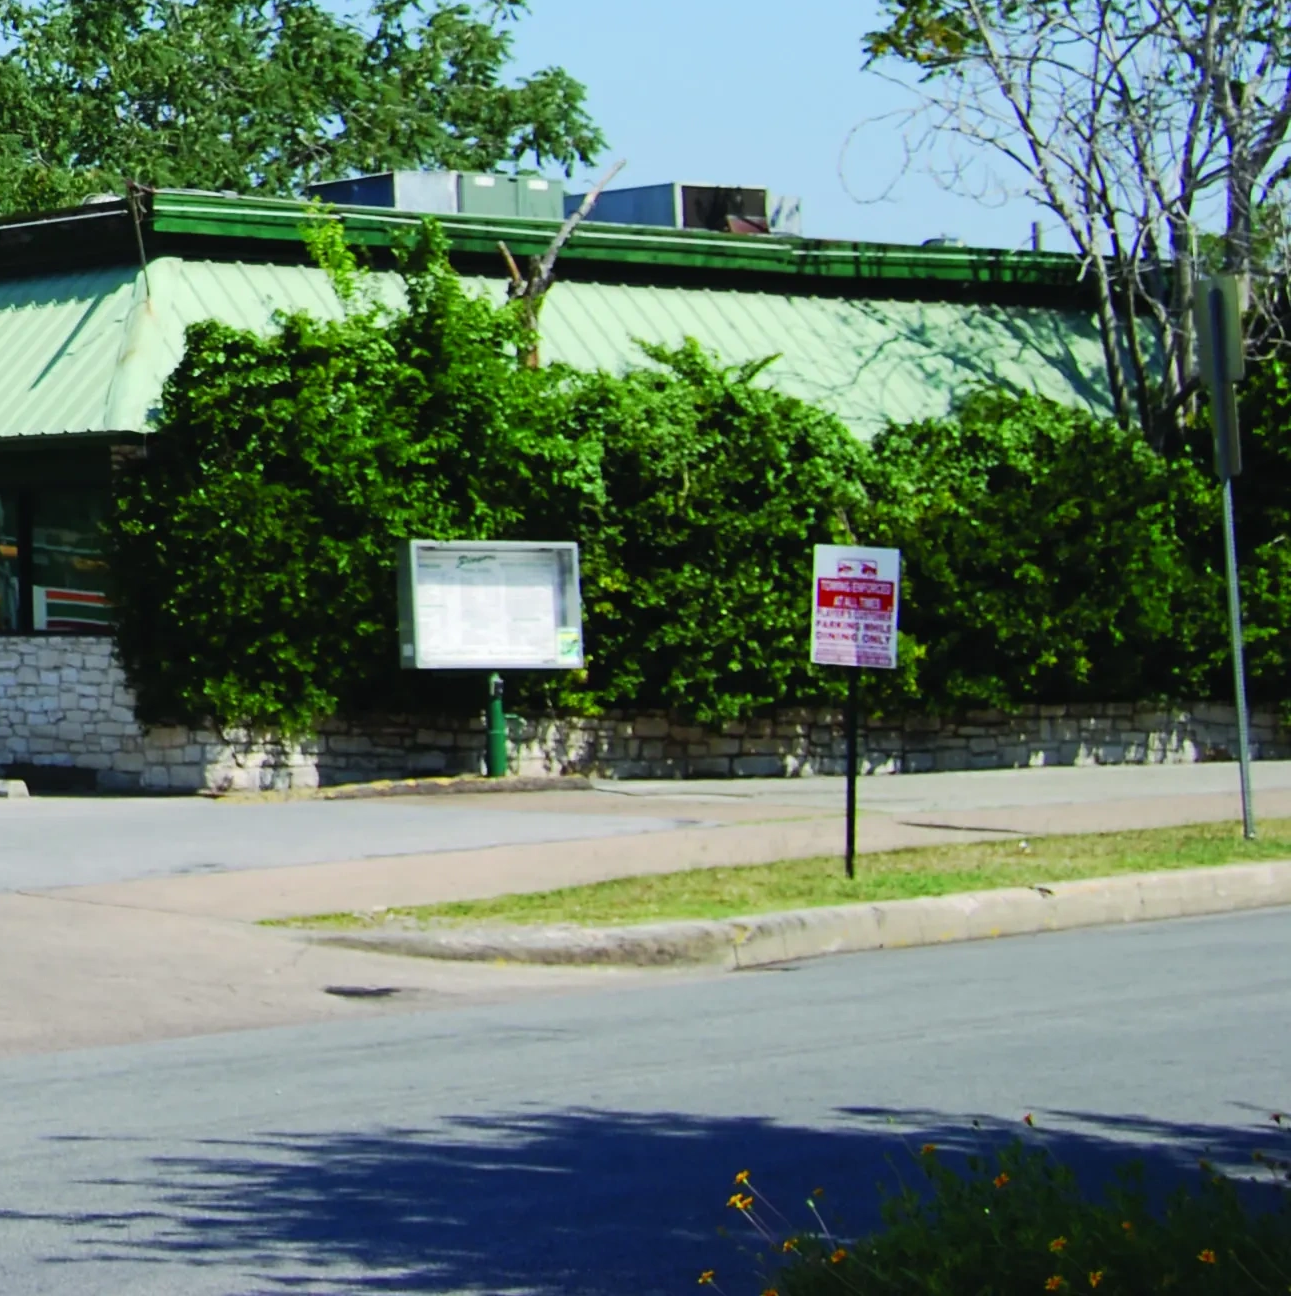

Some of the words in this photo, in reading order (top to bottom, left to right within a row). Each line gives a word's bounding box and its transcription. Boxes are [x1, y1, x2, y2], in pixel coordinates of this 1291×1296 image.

[820, 580, 851, 592] TOWING
[852, 582, 892, 595] ENFORCED
[816, 620, 859, 632] PARKING
[863, 623, 891, 634] WHILE
[816, 632, 859, 643] DINING
[862, 634, 891, 645] ONLY
